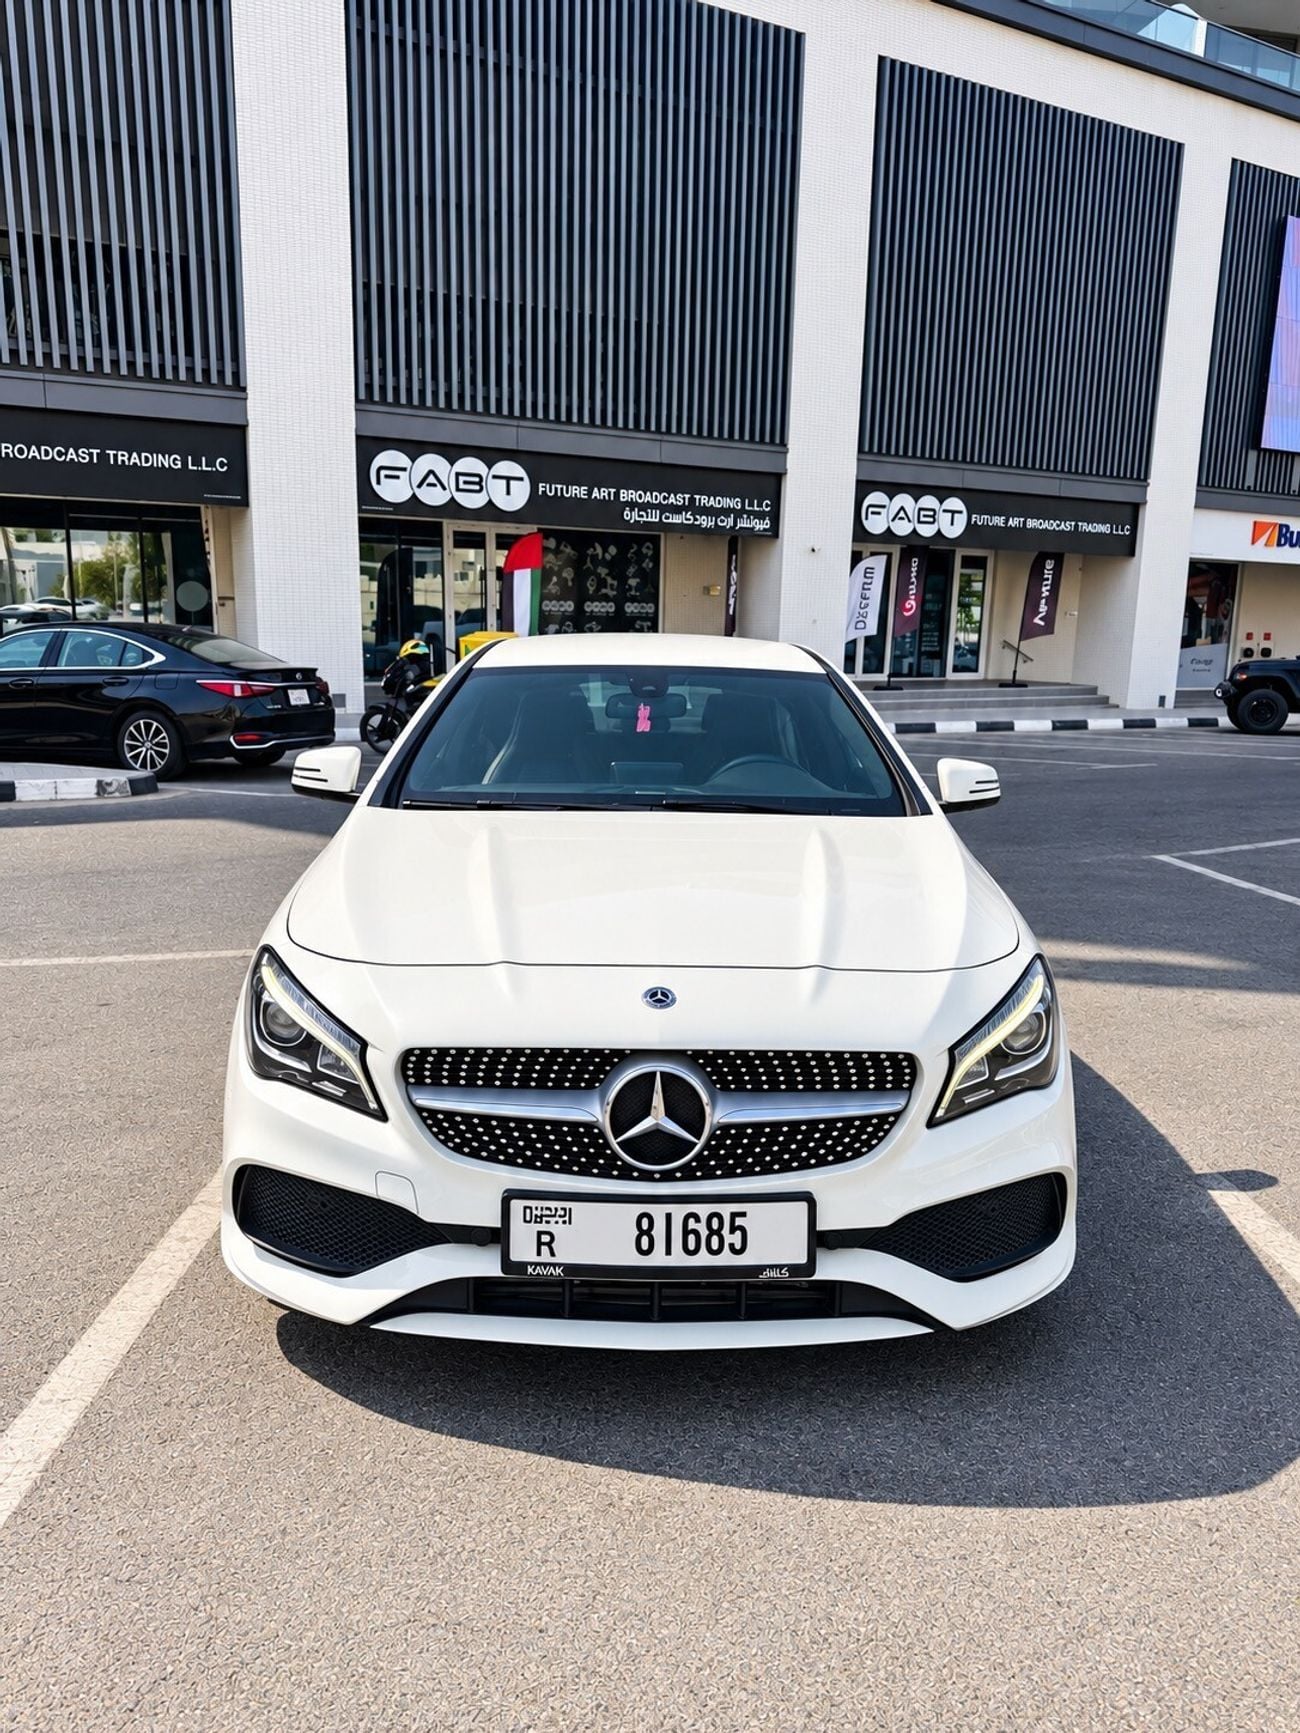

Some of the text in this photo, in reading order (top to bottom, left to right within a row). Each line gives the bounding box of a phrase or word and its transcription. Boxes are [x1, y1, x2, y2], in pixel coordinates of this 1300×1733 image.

[106, 450, 182, 470] TRADING
[188, 455, 228, 472] L.L.C
[538, 483, 772, 512] FUTURE ART BROADCAST TRADING L.L.C
[623, 507, 660, 524] للتجارة
[661, 510, 715, 529] برودكاست
[970, 514, 1006, 527] FUTURE
[1007, 516, 1025, 528] ART
[1026, 518, 1076, 532] BROADCAST
[1078, 521, 1111, 534] TRADING
[1276, 523, 1300, 548] Bu
[536, 1230, 556, 1257] R
[634, 1211, 748, 1257] 81685
[527, 1264, 564, 1277] KAVAK
